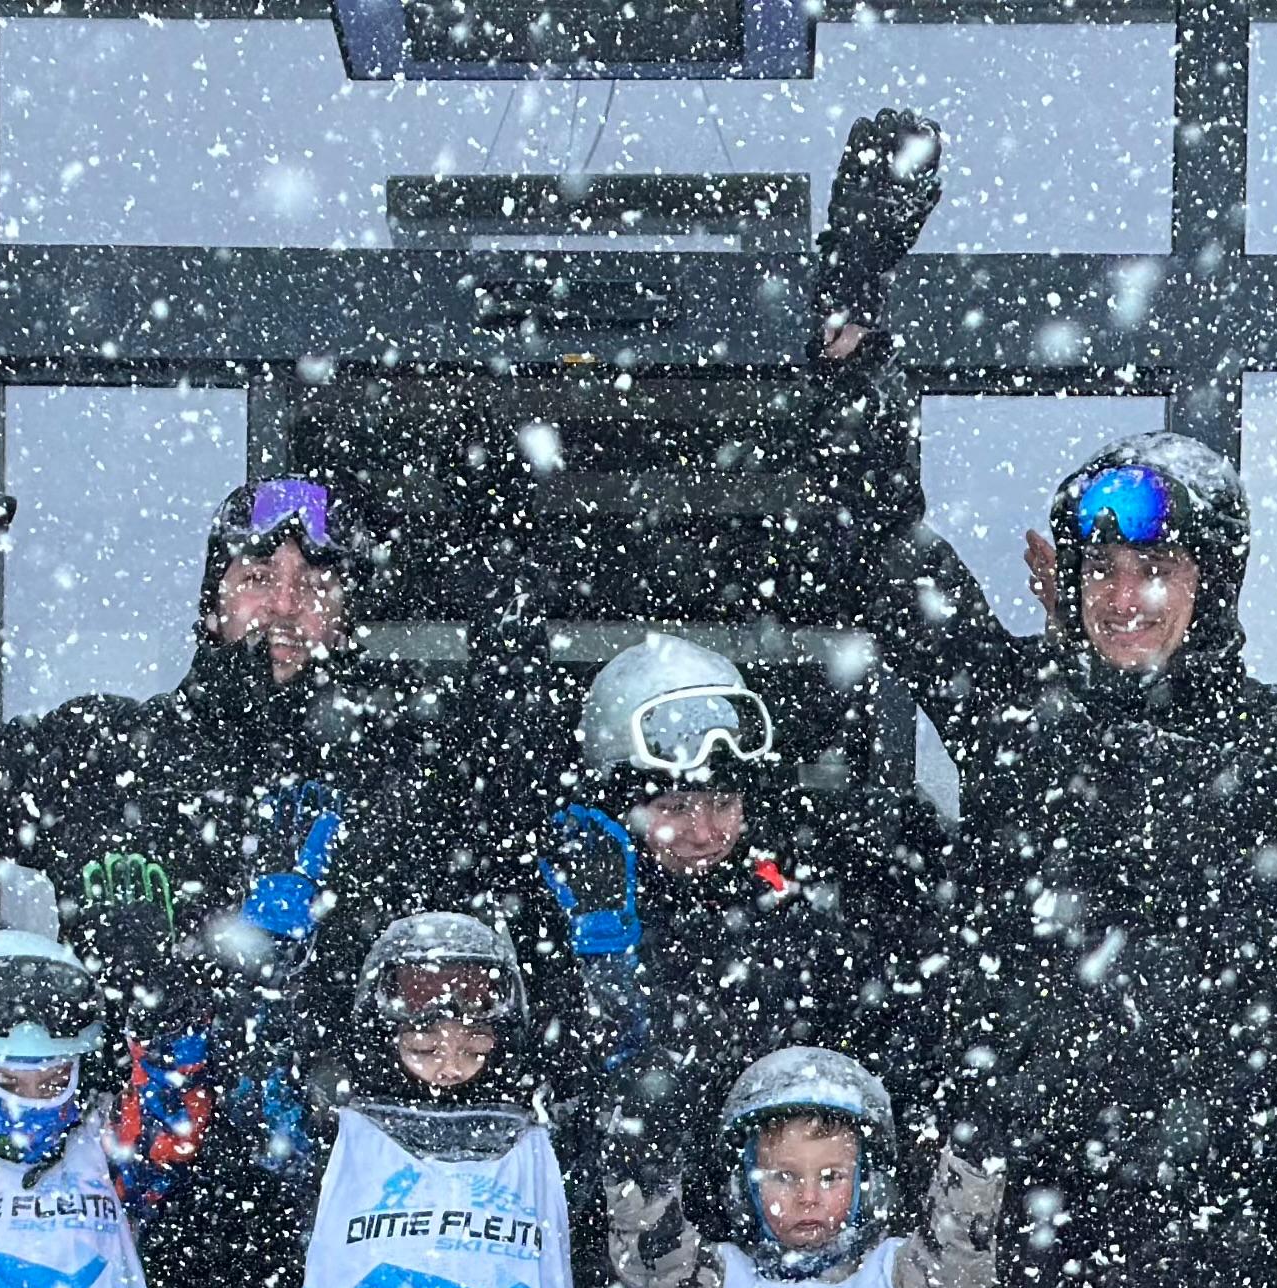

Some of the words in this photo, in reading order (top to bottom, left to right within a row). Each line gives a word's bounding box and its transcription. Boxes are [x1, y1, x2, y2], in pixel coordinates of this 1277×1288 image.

[346, 1210, 433, 1244] DIME
[434, 1237, 481, 1252] SKI
[486, 1243, 541, 1260] CLU
